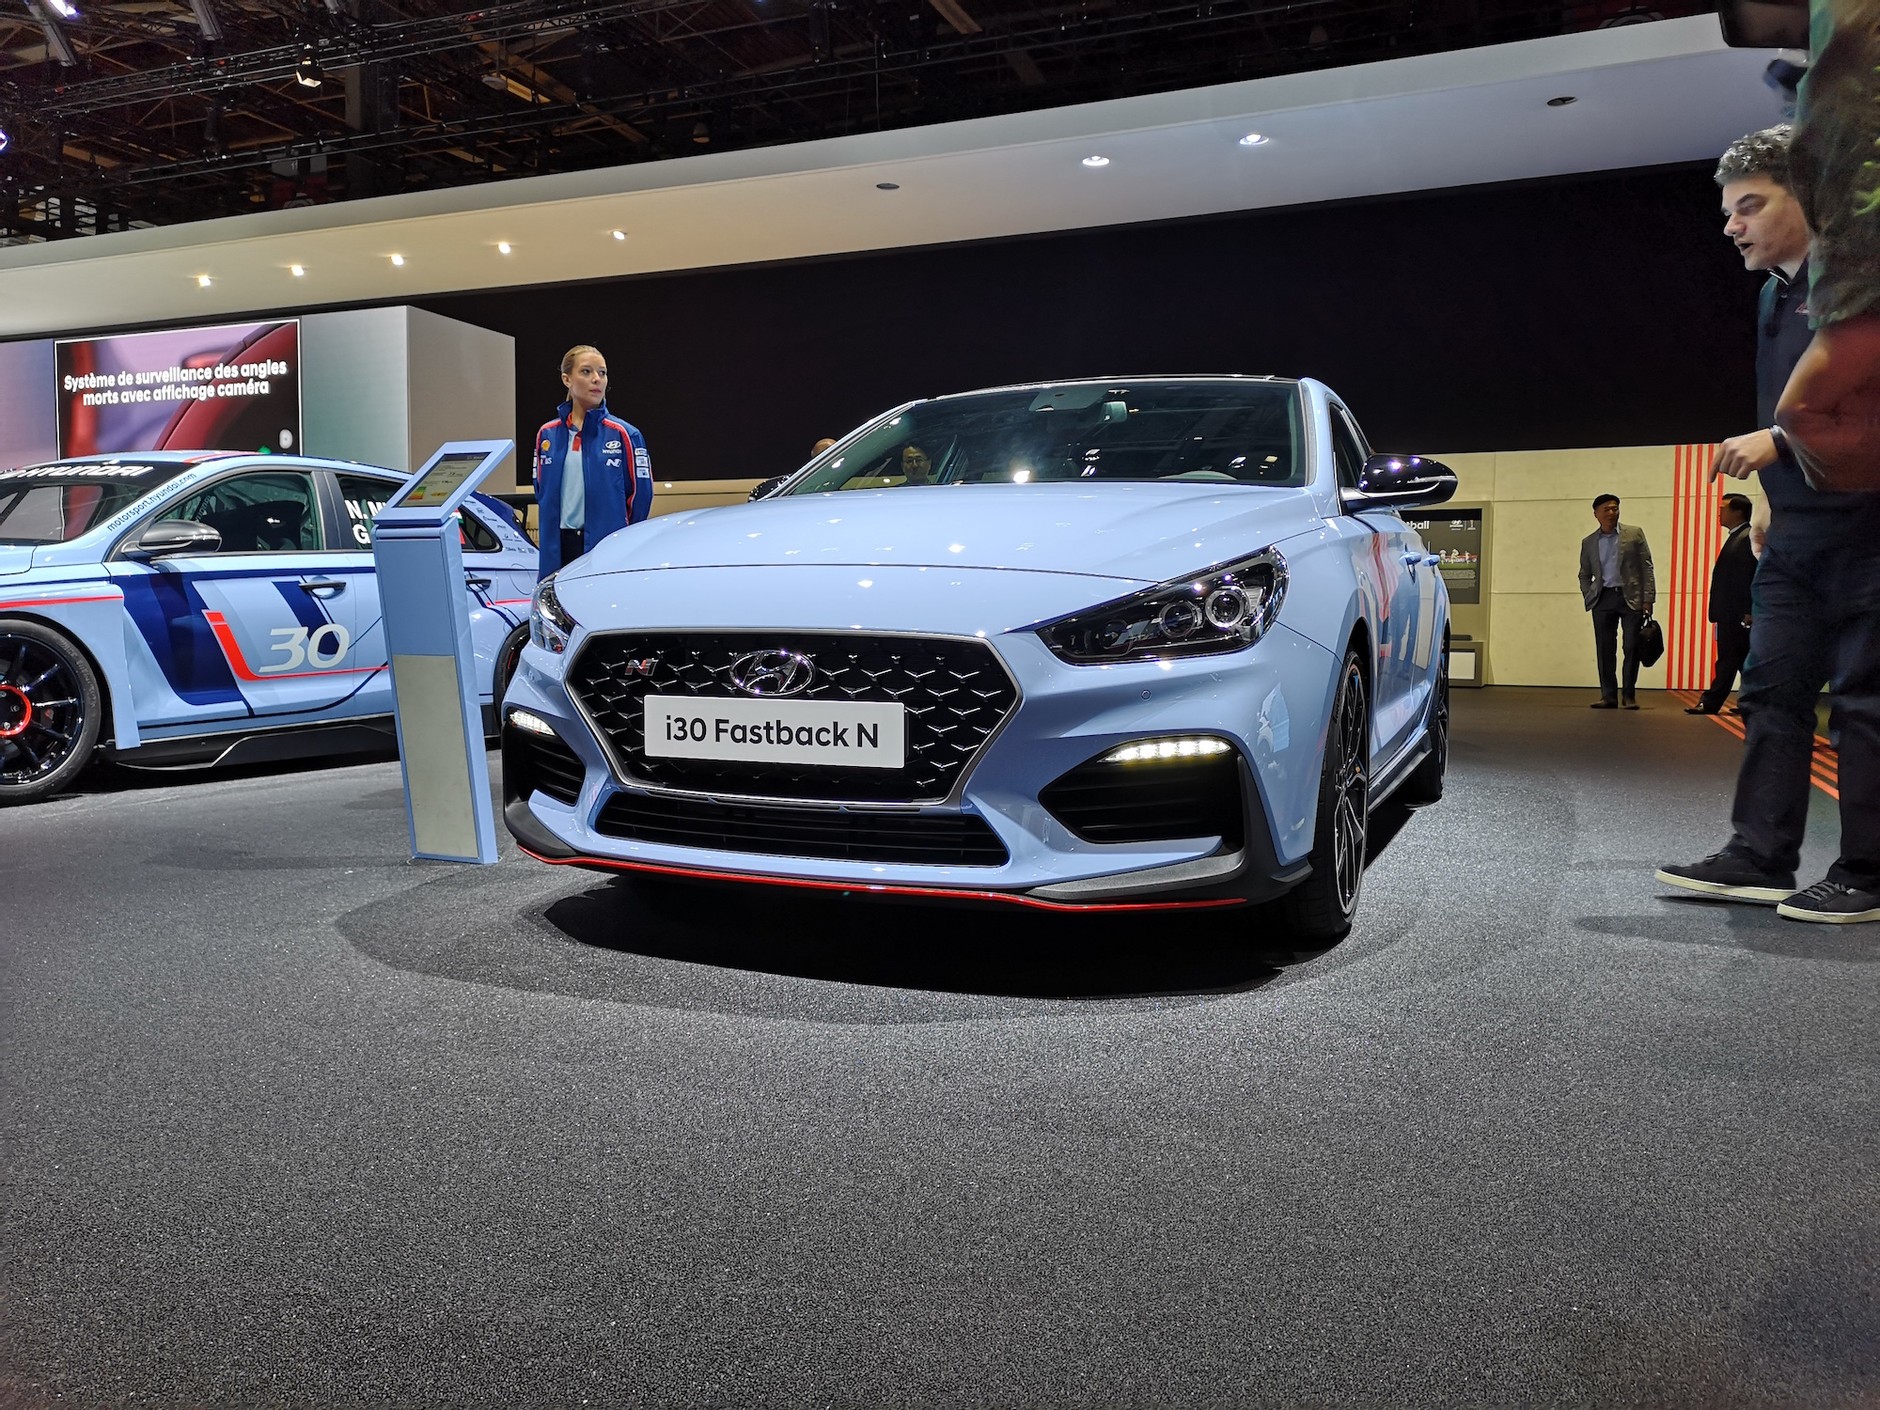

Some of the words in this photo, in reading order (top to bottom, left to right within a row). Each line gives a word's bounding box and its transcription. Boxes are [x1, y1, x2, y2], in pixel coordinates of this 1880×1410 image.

[64, 373, 115, 392] Système
[117, 370, 134, 387] de
[135, 366, 212, 383] surveillance
[214, 363, 238, 378] des
[240, 359, 287, 379] angles
[83, 389, 119, 406] morts
[120, 386, 151, 401] avec
[153, 382, 215, 400] affichage
[217, 379, 269, 396] caméra
[17, 465, 154, 478] HYUNDAI
[106, 473, 197, 532] motorsport.hyundai.com
[344, 500, 368, 519] N.
[260, 623, 350, 673] 30
[666, 714, 707, 742] i30
[715, 718, 849, 747] Fastback
[857, 722, 879, 749] N
